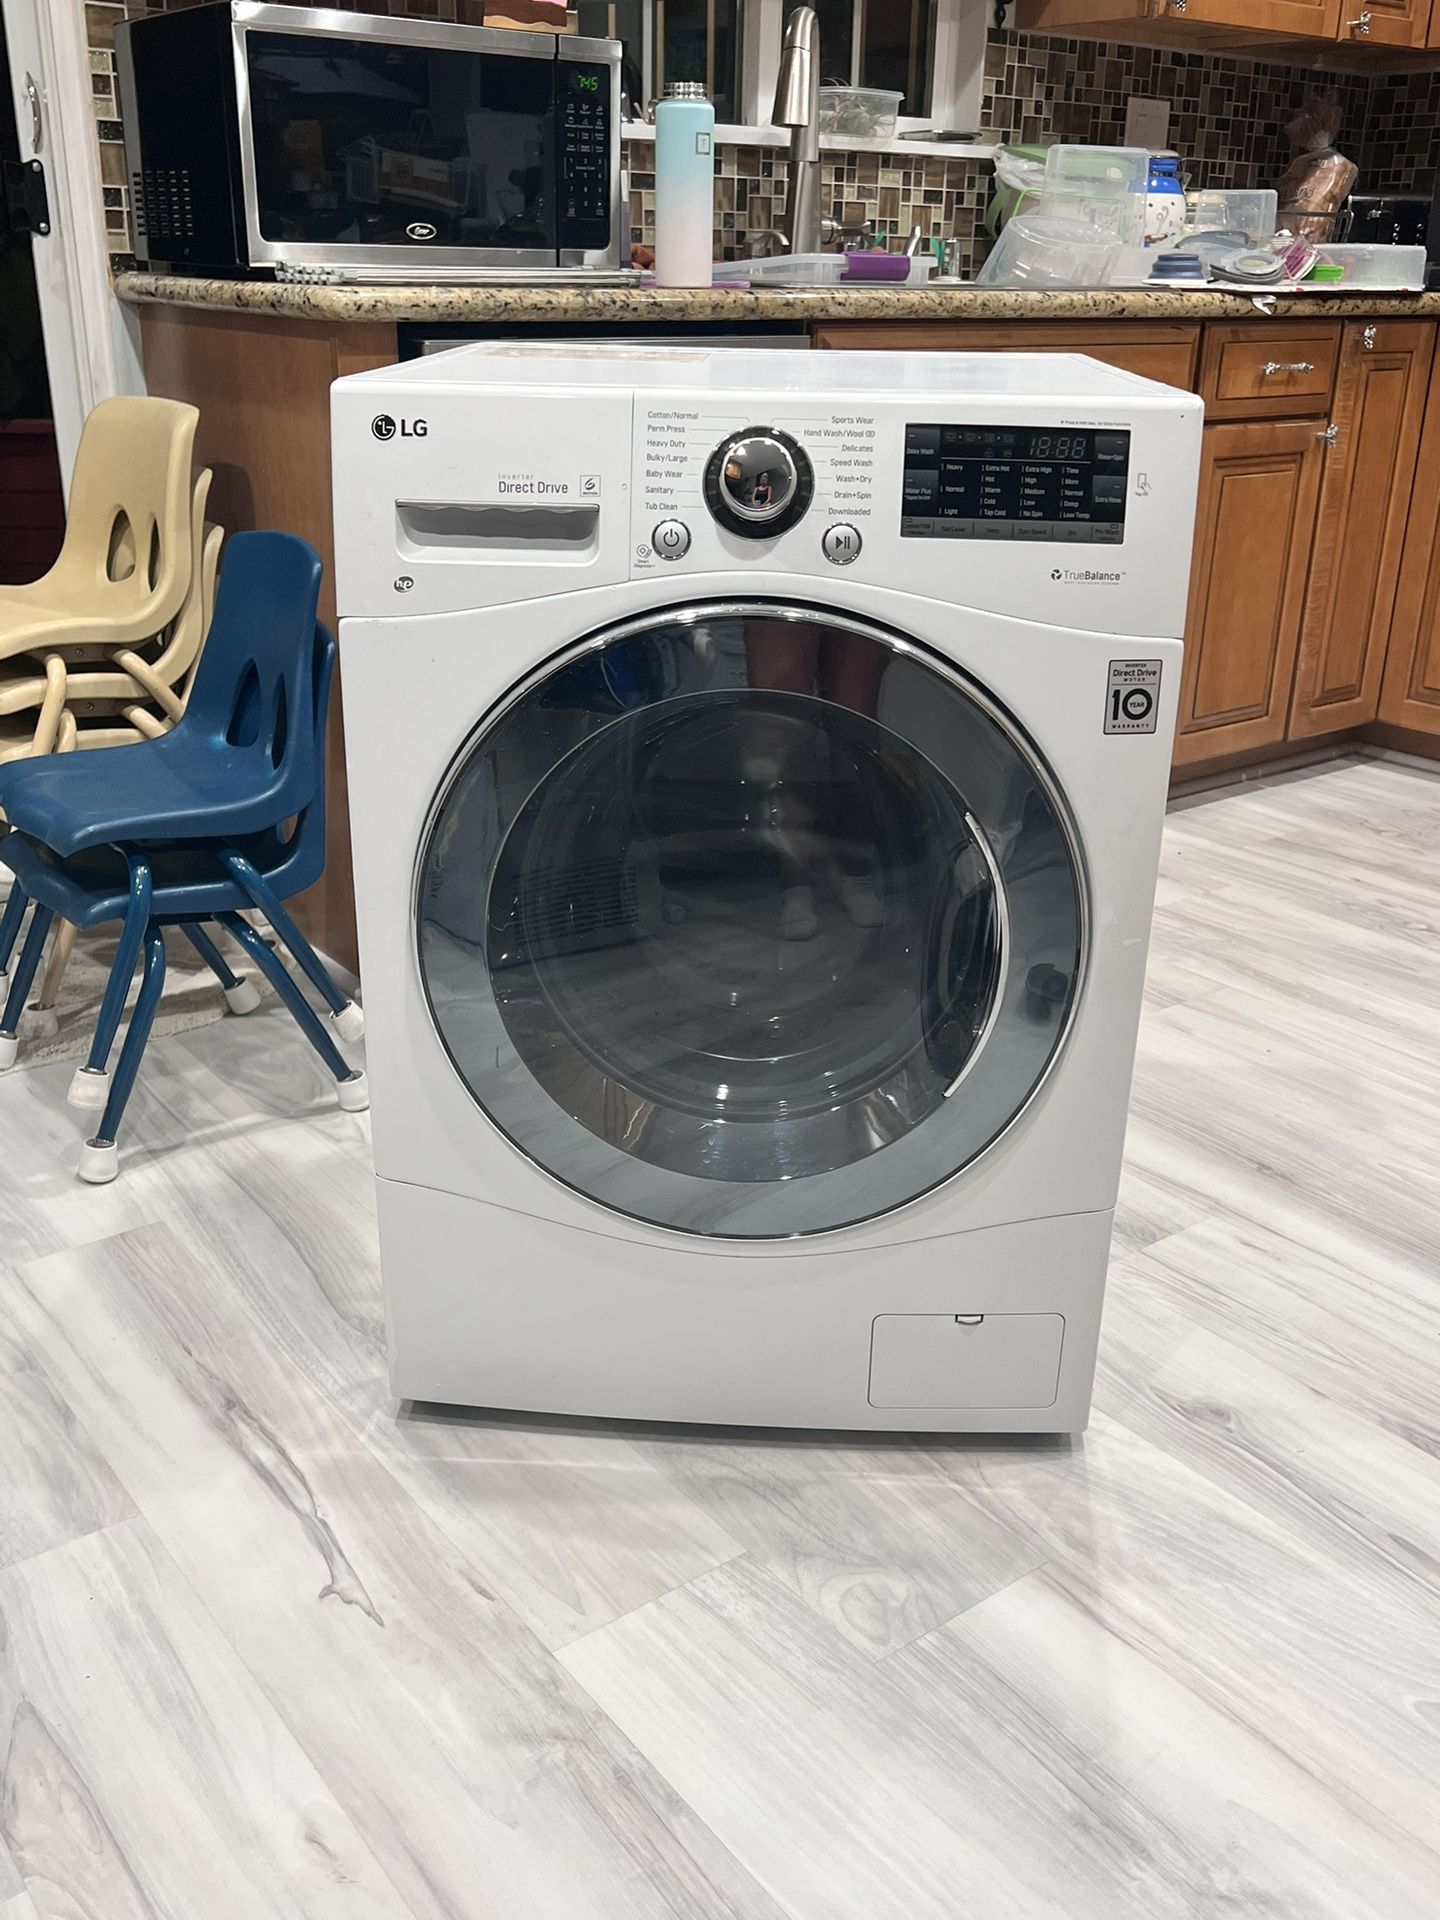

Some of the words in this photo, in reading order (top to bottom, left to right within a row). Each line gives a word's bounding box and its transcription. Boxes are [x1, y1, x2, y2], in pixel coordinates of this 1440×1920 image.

[647, 410, 699, 420] Cotton/Normal
[831, 415, 854, 425] Sports
[855, 416, 874, 424] Wear
[401, 418, 428, 437] LG
[803, 429, 822, 437] Hand
[646, 439, 668, 449] Heavy
[669, 439, 687, 449] Duty
[646, 453, 688, 464] Bulky/Large
[830, 458, 852, 467] Speed
[853, 459, 873, 467] Wash
[645, 469, 663, 479] Baby
[664, 469, 683, 478] Wear
[498, 480, 534, 494] Direct
[537, 481, 569, 494] Drive
[645, 485, 674, 495] Sanitary
[645, 502, 658, 511] Tub
[658, 502, 678, 511] Clean
[828, 506, 872, 516] Downloaded
[1112, 669, 1136, 677] Direct
[1136, 669, 1158, 677] Drive
[1111, 687, 1154, 721] 10
